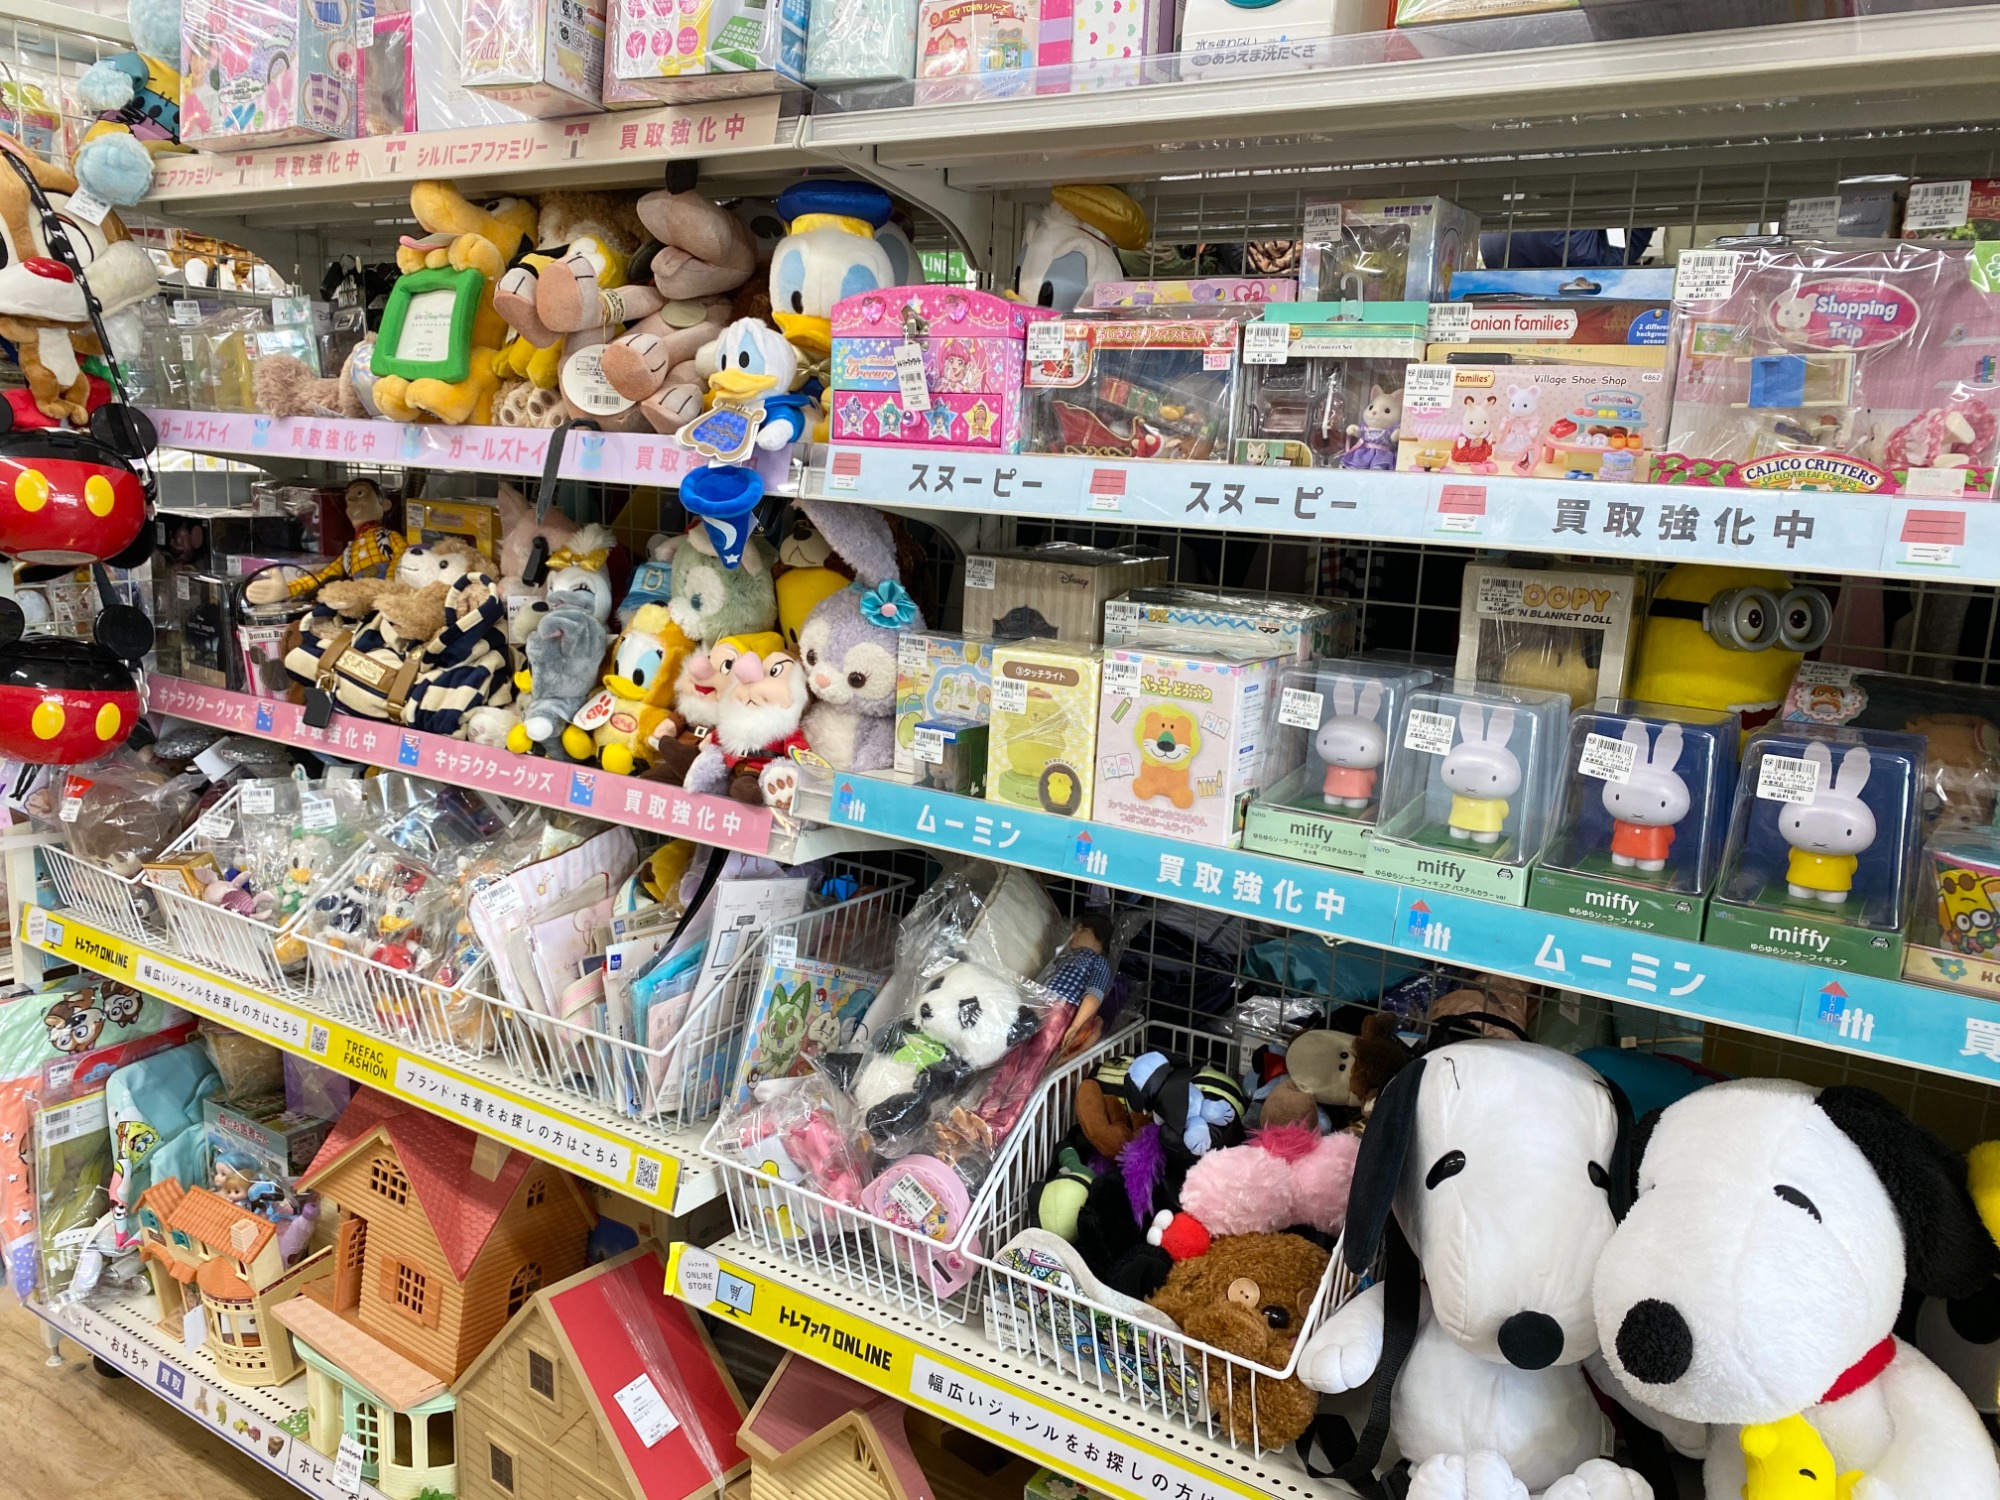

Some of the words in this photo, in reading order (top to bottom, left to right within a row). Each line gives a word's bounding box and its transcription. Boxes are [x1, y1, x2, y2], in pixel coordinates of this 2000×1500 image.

[949, 7, 961, 17] DIY
[963, 4, 983, 13] TOWN
[619, 113, 746, 151] 買取強化中
[274, 150, 361, 178] 買取強化中
[417, 137, 548, 167] シルバニアファミリー
[1816, 294, 1898, 322] Shopping
[1515, 314, 1569, 331] families
[1829, 321, 1863, 346] Trip
[848, 368, 895, 382] Precure
[1534, 374, 1566, 387] Village
[1571, 374, 1596, 386] Shoe
[1601, 376, 1627, 391] Shop
[160, 418, 231, 443] ガールズトイ
[291, 426, 377, 452] 買取強化中
[449, 435, 547, 465] ガールズトイ
[908, 463, 1042, 498] スヌーピー
[1747, 459, 1801, 480] CALICO
[1805, 459, 1878, 486] CRITTERS
[1774, 470, 1820, 483] CLOVERLEAF
[1822, 472, 1858, 488] CORNERS
[1186, 482, 1357, 520] スヌーピー
[1551, 499, 1816, 549] 買取強化中
[1058, 571, 1089, 588] Disney
[1523, 584, 1611, 612] OOPY
[1531, 610, 1580, 623] BLANKET
[1582, 615, 1612, 627] DOLL
[248, 632, 273, 641] DOUBLE
[159, 687, 245, 721] キャラクターグッズ
[435, 752, 556, 793] キャラクターグッズ
[623, 788, 742, 837] 買取強化中
[917, 804, 1021, 848] ムーミン
[1253, 833, 1320, 850] ゆらゆらソーラーフィギュア
[1321, 845, 1358, 857] パステルカラー
[1290, 822, 1333, 843] miffy
[1375, 869, 1451, 893] ゆらゆらソーラーフィギュア
[1452, 886, 1494, 899] パステルカラー
[1418, 859, 1466, 882] miffy
[1156, 852, 1345, 921] 買取強化中
[1585, 891, 1640, 916] miffy
[1569, 907, 1655, 929] ゆらゆらソーラーフィギュア
[75, 936, 100, 961] トレファク
[100, 947, 129, 970] ONLINE
[1769, 926, 1831, 953] miffy
[1534, 934, 1706, 996] ムーミン
[1751, 943, 1848, 967] ゆらゆらソーラーフィギュア
[814, 966, 834, 976] Scarlet
[866, 975, 882, 985] Violet
[144, 965, 300, 1038] 幅広いジャンルをお探しの方はこちら
[345, 1039, 385, 1064] TREFAC
[343, 1053, 389, 1081] FASHION
[218, 1112, 270, 1145] 森のお医者さん
[407, 1071, 619, 1168] ブランド・古着をお探しの方はこちら
[685, 1270, 714, 1281] ONLINE
[688, 1281, 713, 1292] STORE
[779, 1305, 831, 1344] トレファク
[832, 1333, 893, 1372] ONLINE
[160, 1367, 183, 1393] 買取
